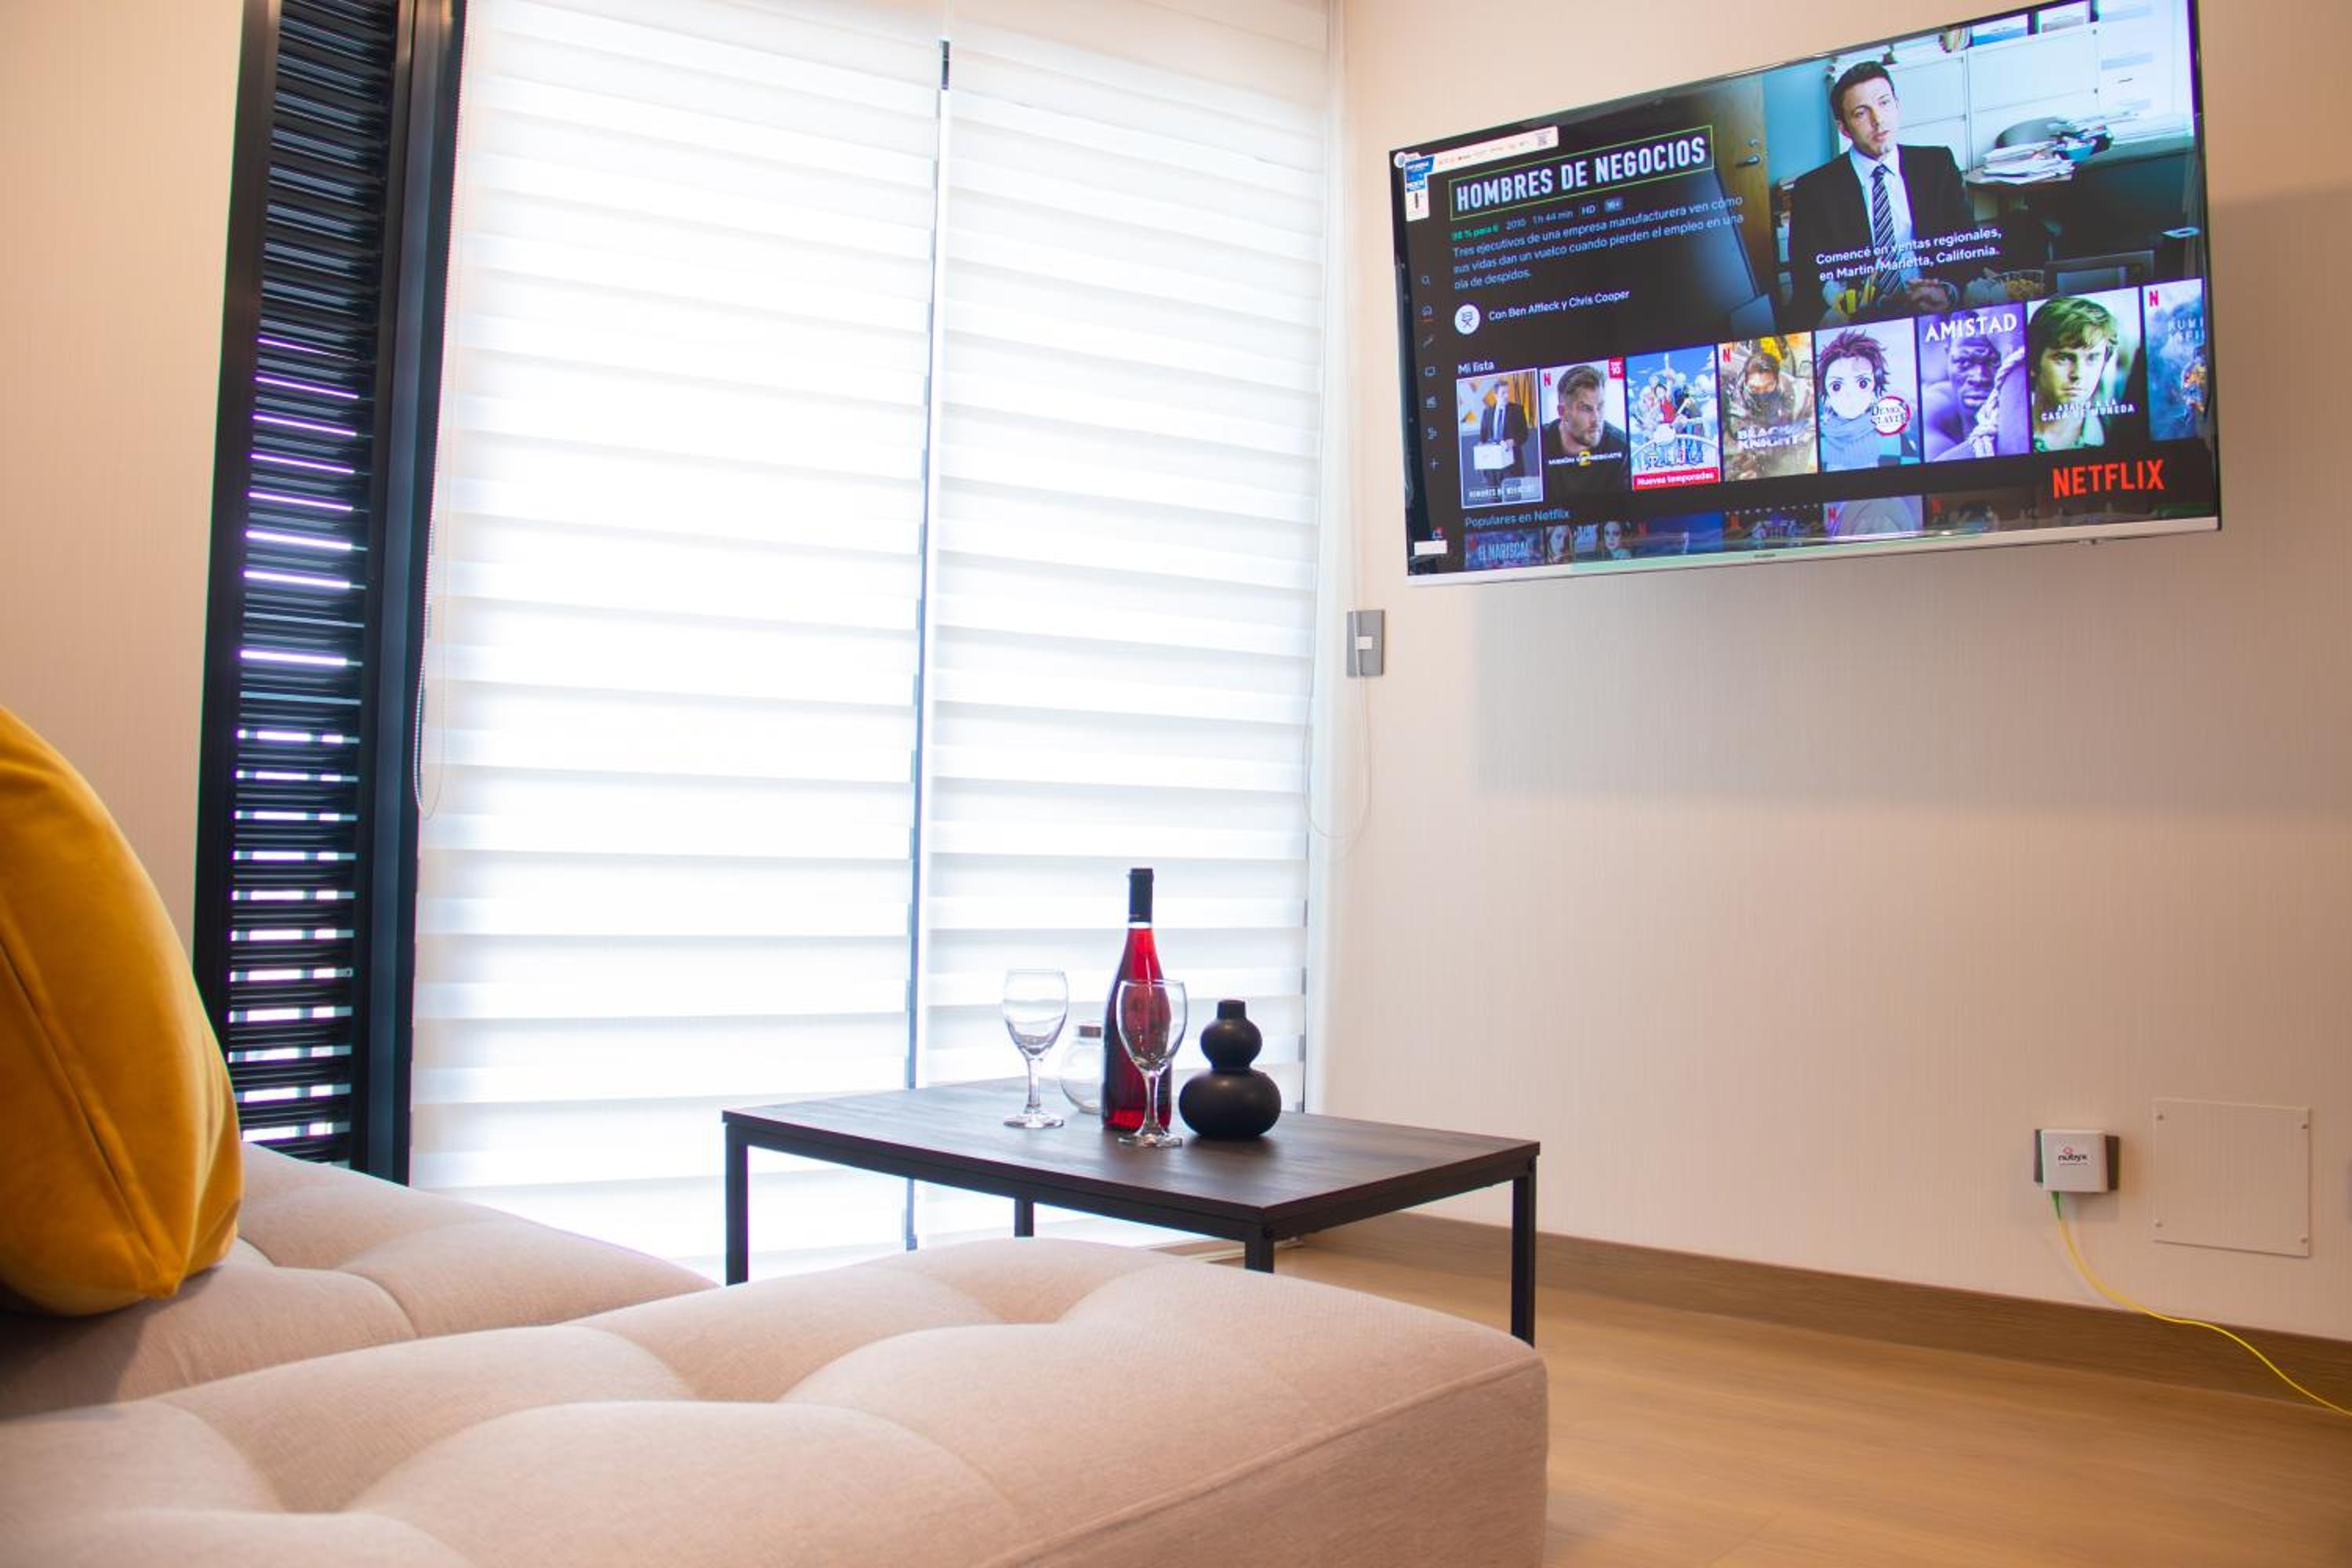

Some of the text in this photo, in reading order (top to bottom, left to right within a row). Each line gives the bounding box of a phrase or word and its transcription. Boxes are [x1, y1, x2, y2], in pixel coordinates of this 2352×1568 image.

[1456, 168, 1553, 212] HOMBRES
[1561, 159, 1588, 191] DE
[1595, 136, 1706, 184] NEGOCIOS
[1556, 210, 1573, 220] min
[1581, 205, 1596, 215] HD
[1454, 195, 1744, 258] Tres ejecutivos de una empresa manufacturera ven cómo
[1454, 214, 1744, 274] sus vidas dan un vuelco cuando pierden el empleo en una
[1816, 228, 2002, 265] Comencé en ventas regionales,
[1470, 274, 1483, 287] de
[1484, 268, 1531, 285] despidos.
[1819, 245, 1999, 281] en Martin Marietta, California.
[1489, 289, 1631, 321] Con Ben Affleck y Chris Cooper
[1925, 313, 2019, 343] AMISTAD
[1457, 360, 1495, 375] Mi lista
[2041, 412, 2069, 422] CASA
[2091, 404, 2135, 417] MONEDA
[1636, 471, 1715, 487] Nuevas temporadas
[2052, 459, 2165, 499] NETFLIX
[1465, 508, 1570, 528] Populares en Netflix
